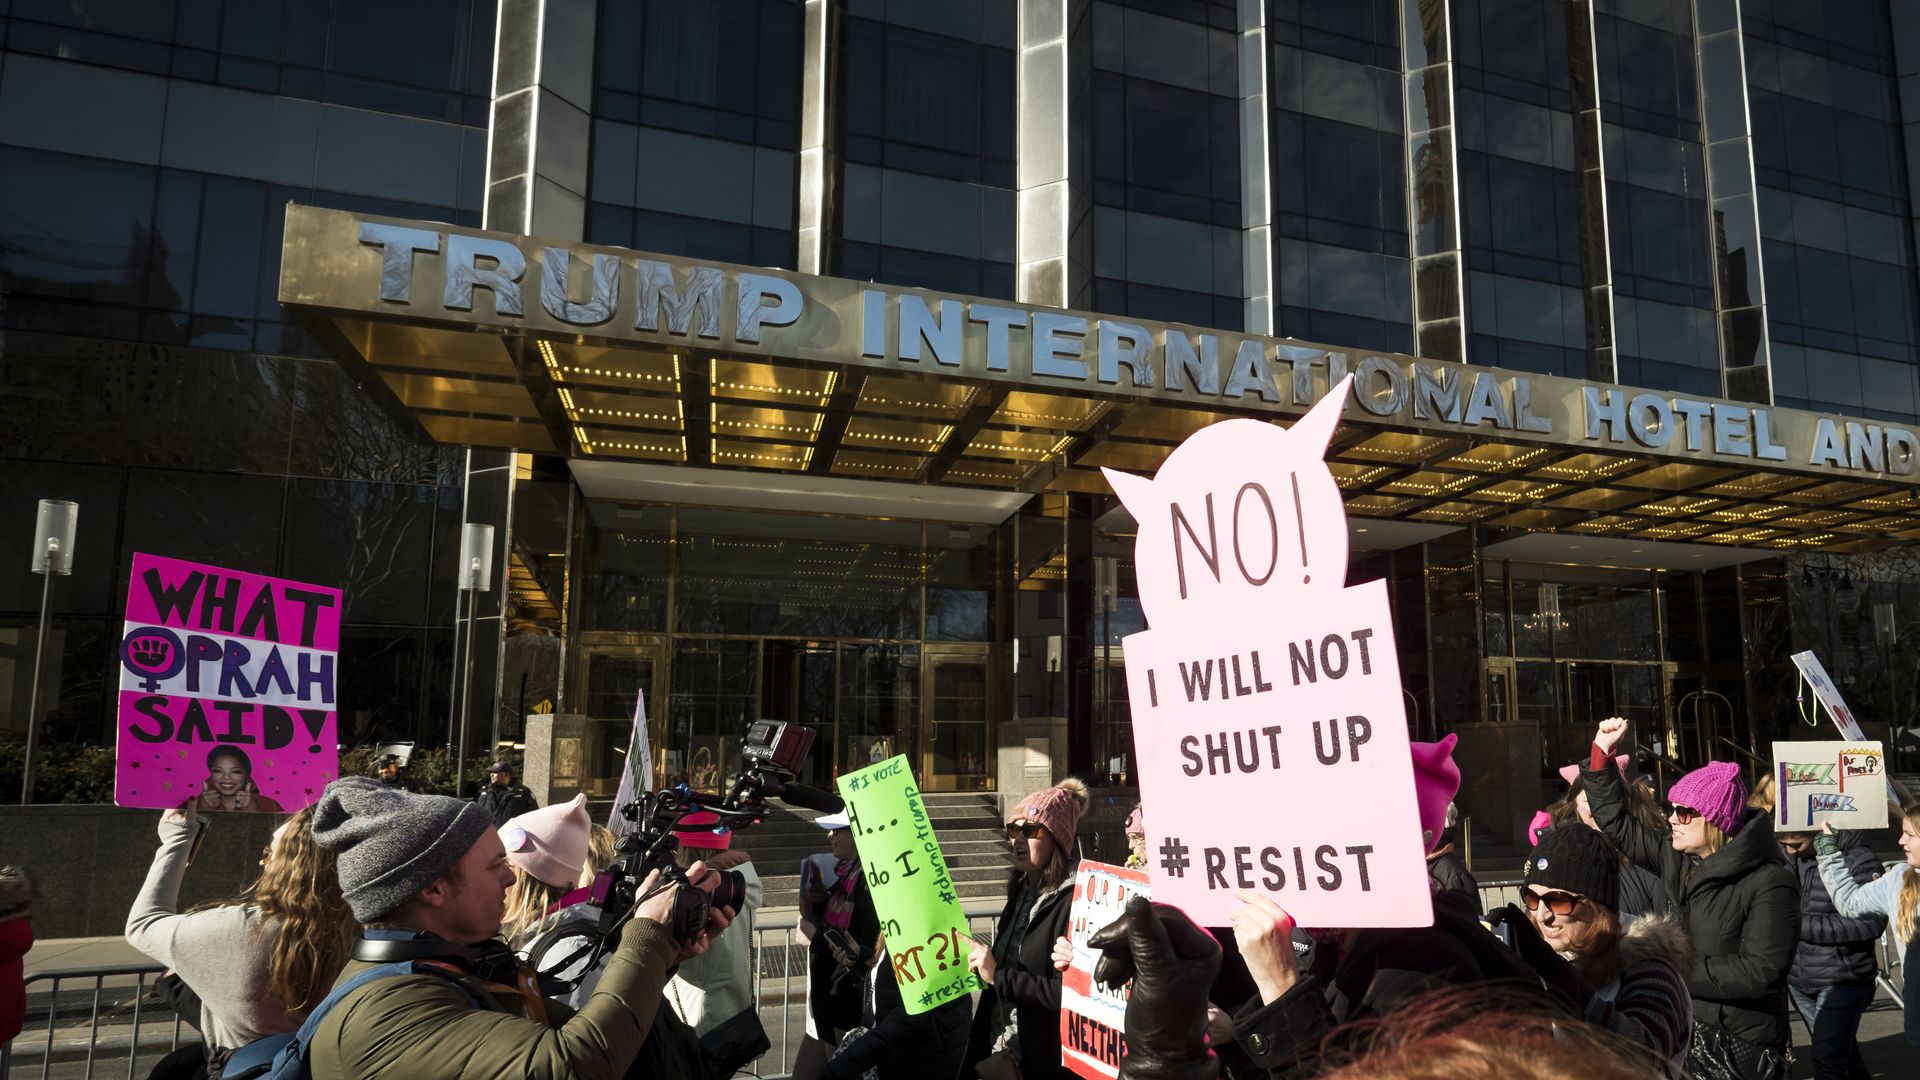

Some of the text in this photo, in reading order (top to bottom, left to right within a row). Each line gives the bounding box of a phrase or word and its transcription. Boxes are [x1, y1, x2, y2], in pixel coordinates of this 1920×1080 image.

[358, 221, 1920, 476] TRUMP INTERNATIONAL HOTEL AND
[1169, 471, 1311, 600] NO!
[142, 567, 335, 649] WHAT
[120, 626, 335, 704] OPRAH
[1147, 627, 1373, 708] I WILL NOT
[128, 694, 328, 754] SAID!
[1179, 715, 1373, 778] SHUT UP
[873, 759, 903, 783] VOTE
[868, 849, 920, 888] do I
[1086, 875, 1110, 907] OUR
[1159, 836, 1374, 892] #RESIST
[1068, 1009, 1129, 1068] NEITHE
